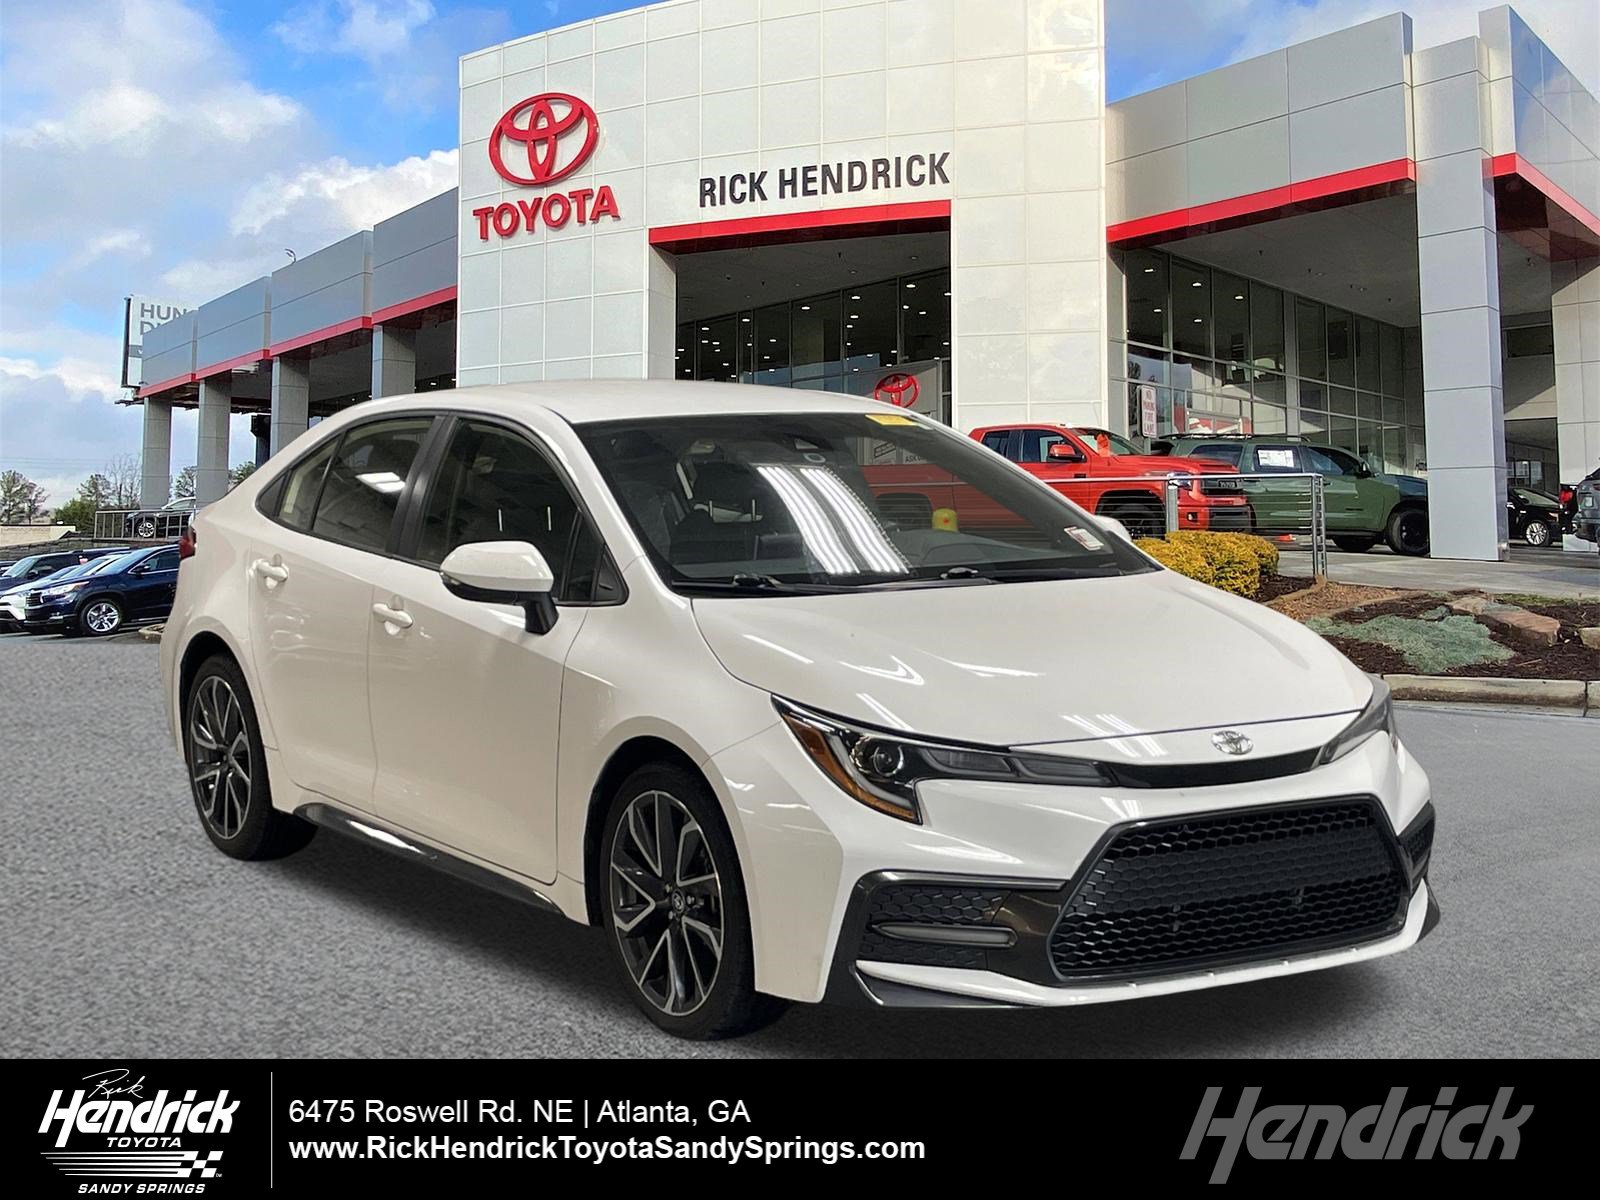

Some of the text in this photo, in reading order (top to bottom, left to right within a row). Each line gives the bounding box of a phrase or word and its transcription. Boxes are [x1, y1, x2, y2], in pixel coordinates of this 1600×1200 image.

[699, 152, 950, 208] RICK HENDRICK
[473, 185, 621, 240] TOYOTA
